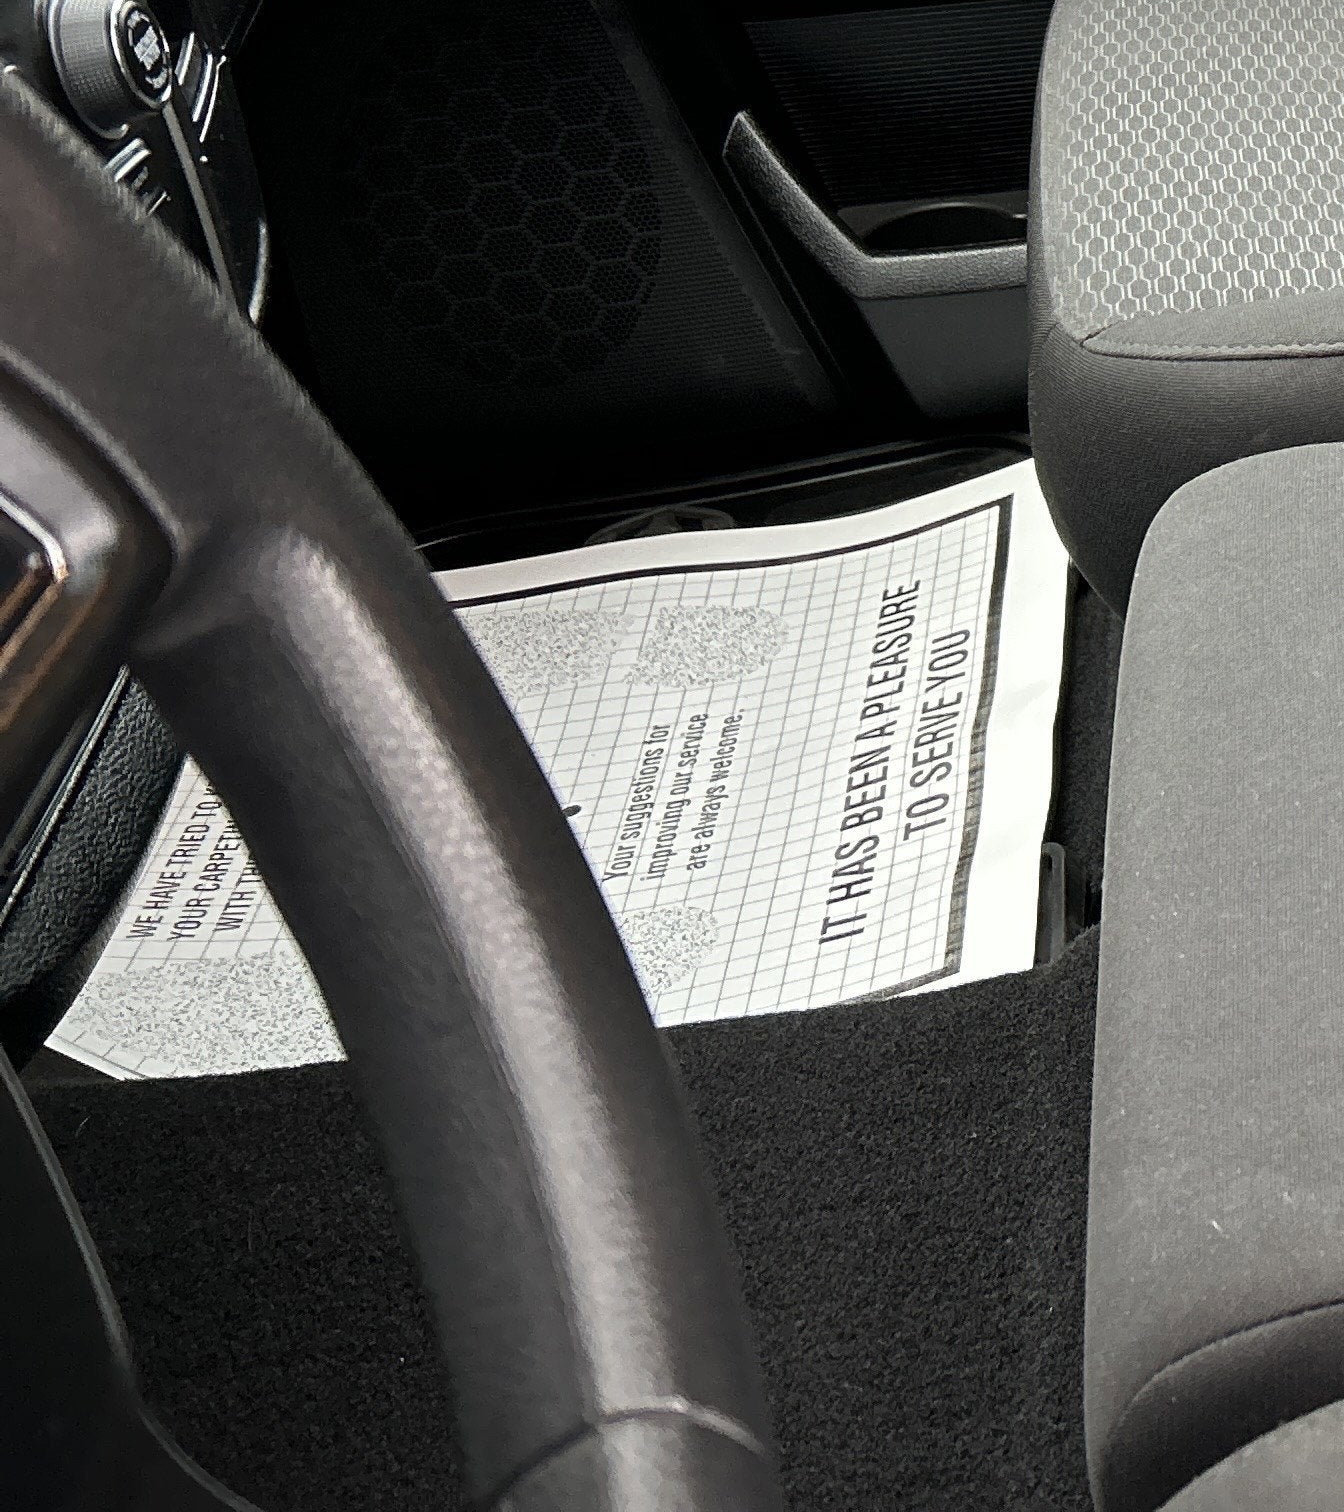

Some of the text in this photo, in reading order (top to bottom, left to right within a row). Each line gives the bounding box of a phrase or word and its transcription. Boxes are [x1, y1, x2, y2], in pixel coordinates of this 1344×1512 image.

[602, 724, 670, 882] Your suggestions for
[640, 713, 708, 881] improving our service
[686, 708, 745, 871] are always welcome.
[819, 579, 921, 945] IT HAS BEEN A PLEASURE
[903, 629, 971, 840] TO SERVE YOU
[125, 801, 222, 939] WE HAVE TRIED TO
[167, 897, 214, 942] YOUR
[212, 890, 256, 931] WITH
